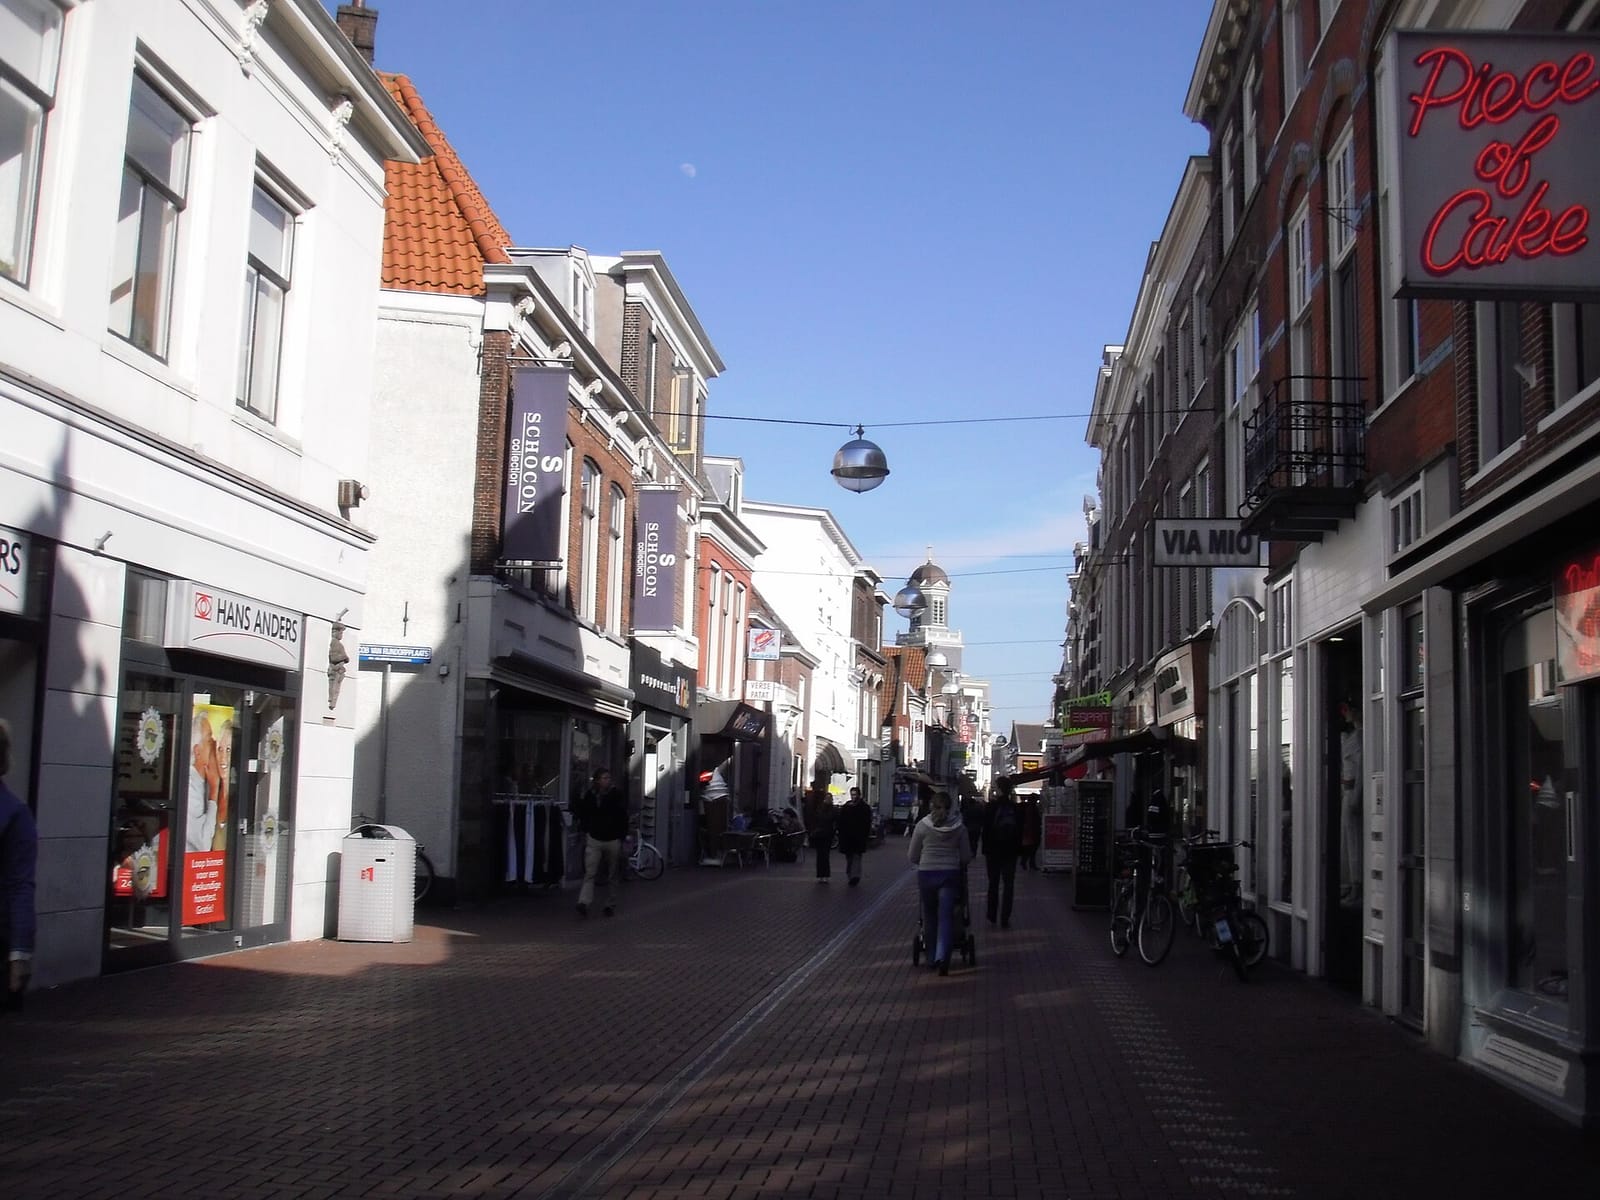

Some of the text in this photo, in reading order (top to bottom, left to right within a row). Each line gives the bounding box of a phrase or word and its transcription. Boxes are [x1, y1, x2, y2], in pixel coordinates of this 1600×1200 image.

[1409, 47, 1600, 136] Piece
[1476, 114, 1560, 196] of
[1423, 181, 1589, 271] Cake
[510, 438, 522, 486] collection
[521, 412, 541, 515] SCHOCON
[541, 455, 563, 473] S
[646, 522, 659, 598] SCHOCON
[1162, 529, 1253, 555] VIA MIO
[216, 597, 298, 643] HANS ANDERS
[640, 673, 677, 694] peppermint
[750, 681, 771, 690] VERSE
[750, 691, 769, 699] PATAT
[1072, 712, 1110, 722] ESPRIT
